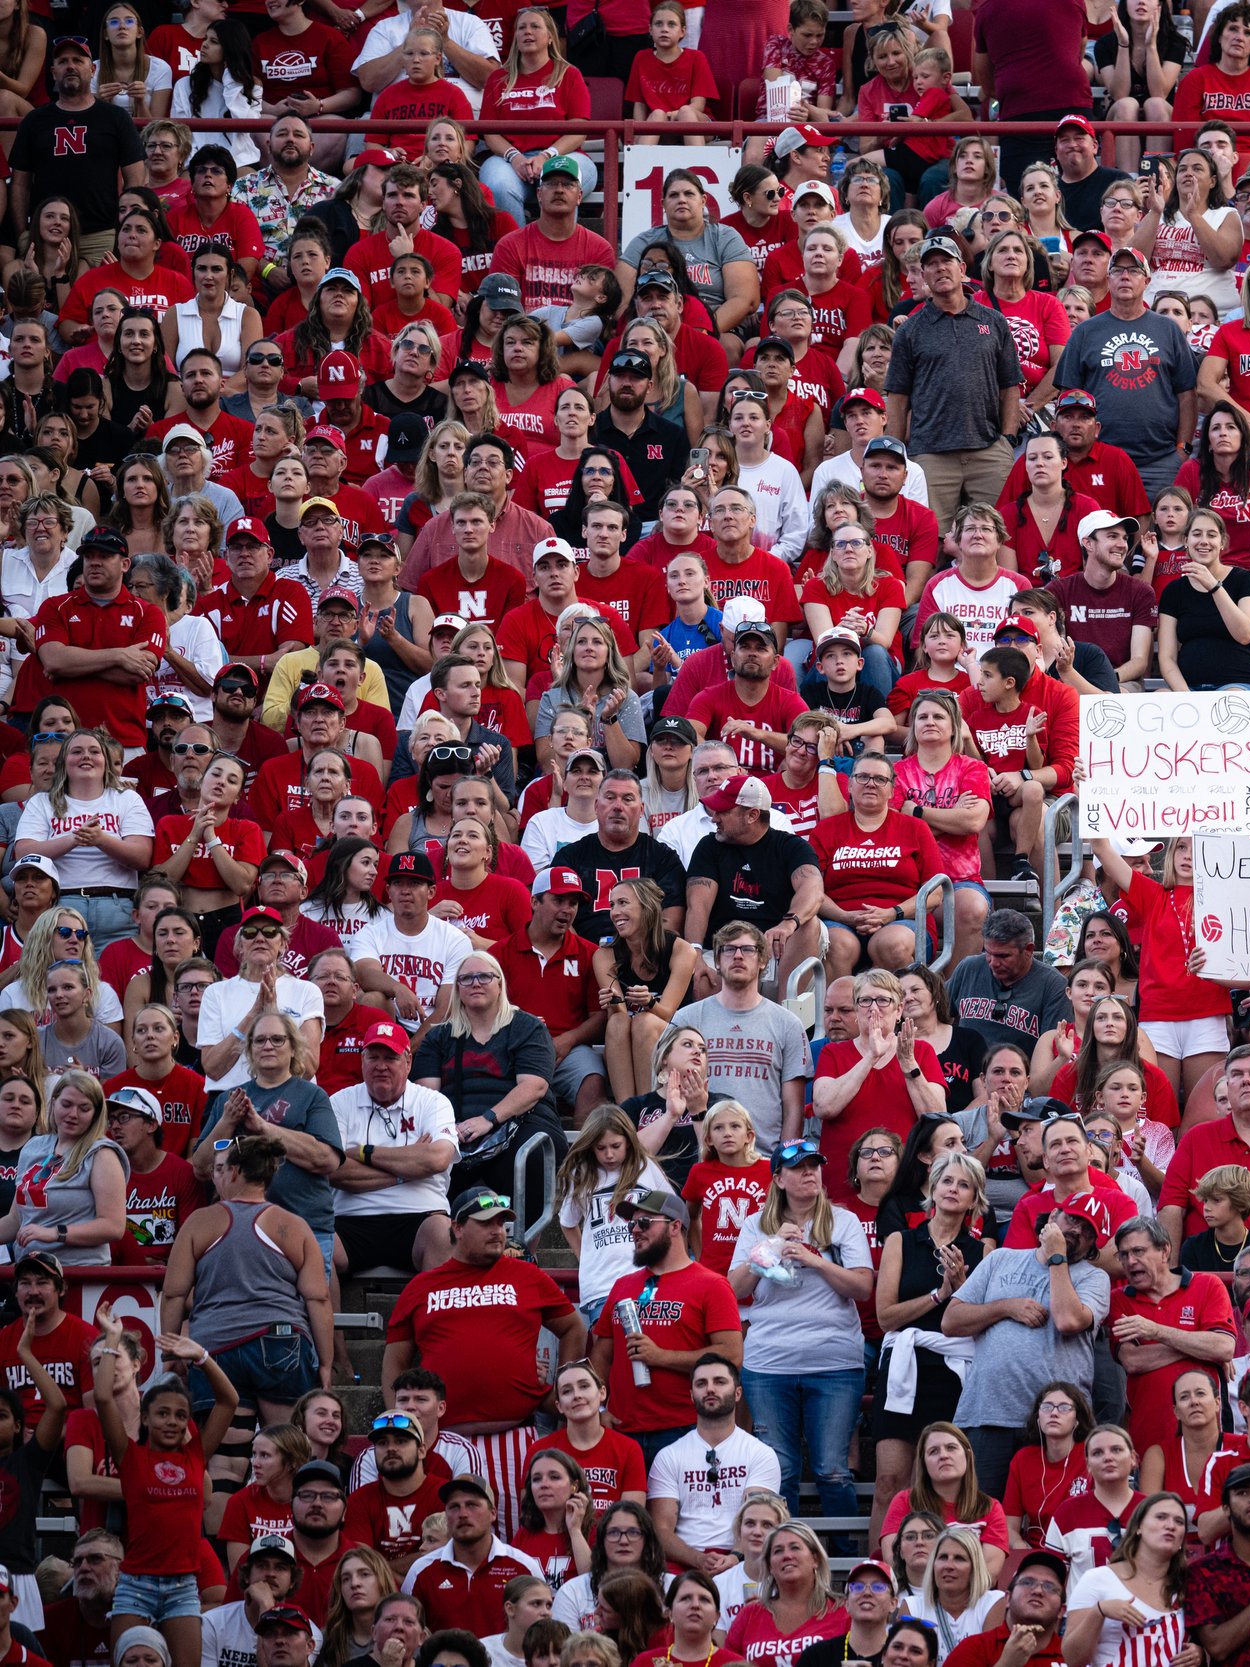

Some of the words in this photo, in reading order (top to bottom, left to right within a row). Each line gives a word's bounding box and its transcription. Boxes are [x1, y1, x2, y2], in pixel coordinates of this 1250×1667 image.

[268, 68, 286, 76] 250
[53, 126, 87, 155] N
[930, 238, 943, 246] N
[978, 324, 991, 334] N
[811, 334, 823, 343] N
[1101, 332, 1159, 356] NEBRASKA
[1121, 351, 1141, 370] N
[328, 366, 344, 380] N
[1104, 367, 1158, 390] HUSKERS
[850, 389, 865, 397] N
[360, 440, 371, 449] N
[647, 446, 662, 459] N
[1091, 474, 1104, 485] N
[237, 519, 252, 529] N
[257, 605, 269, 616] N
[457, 591, 486, 618] N
[1070, 606, 1087, 622] N
[120, 616, 133, 626] N
[1006, 616, 1019, 626] N
[1136, 703, 1200, 733] GO
[1087, 803, 1100, 832] ACE
[1103, 801, 1236, 832] Volleyball
[1199, 826, 1242, 834] Grannie
[833, 845, 901, 862] NEBRASKA
[399, 856, 415, 869] N
[838, 860, 891, 869] VOLLEYBALL
[563, 960, 579, 976] N
[377, 1024, 393, 1036] N
[344, 1037, 356, 1046] N
[400, 1117, 415, 1131] N
[716, 1198, 750, 1229] N
[1084, 1198, 1101, 1216] N
[427, 1284, 517, 1303] NEBRASKA
[427, 1294, 517, 1314] HUSKERS
[147, 1487, 197, 1495] VOLLEYBALL
[387, 1504, 416, 1538] N
